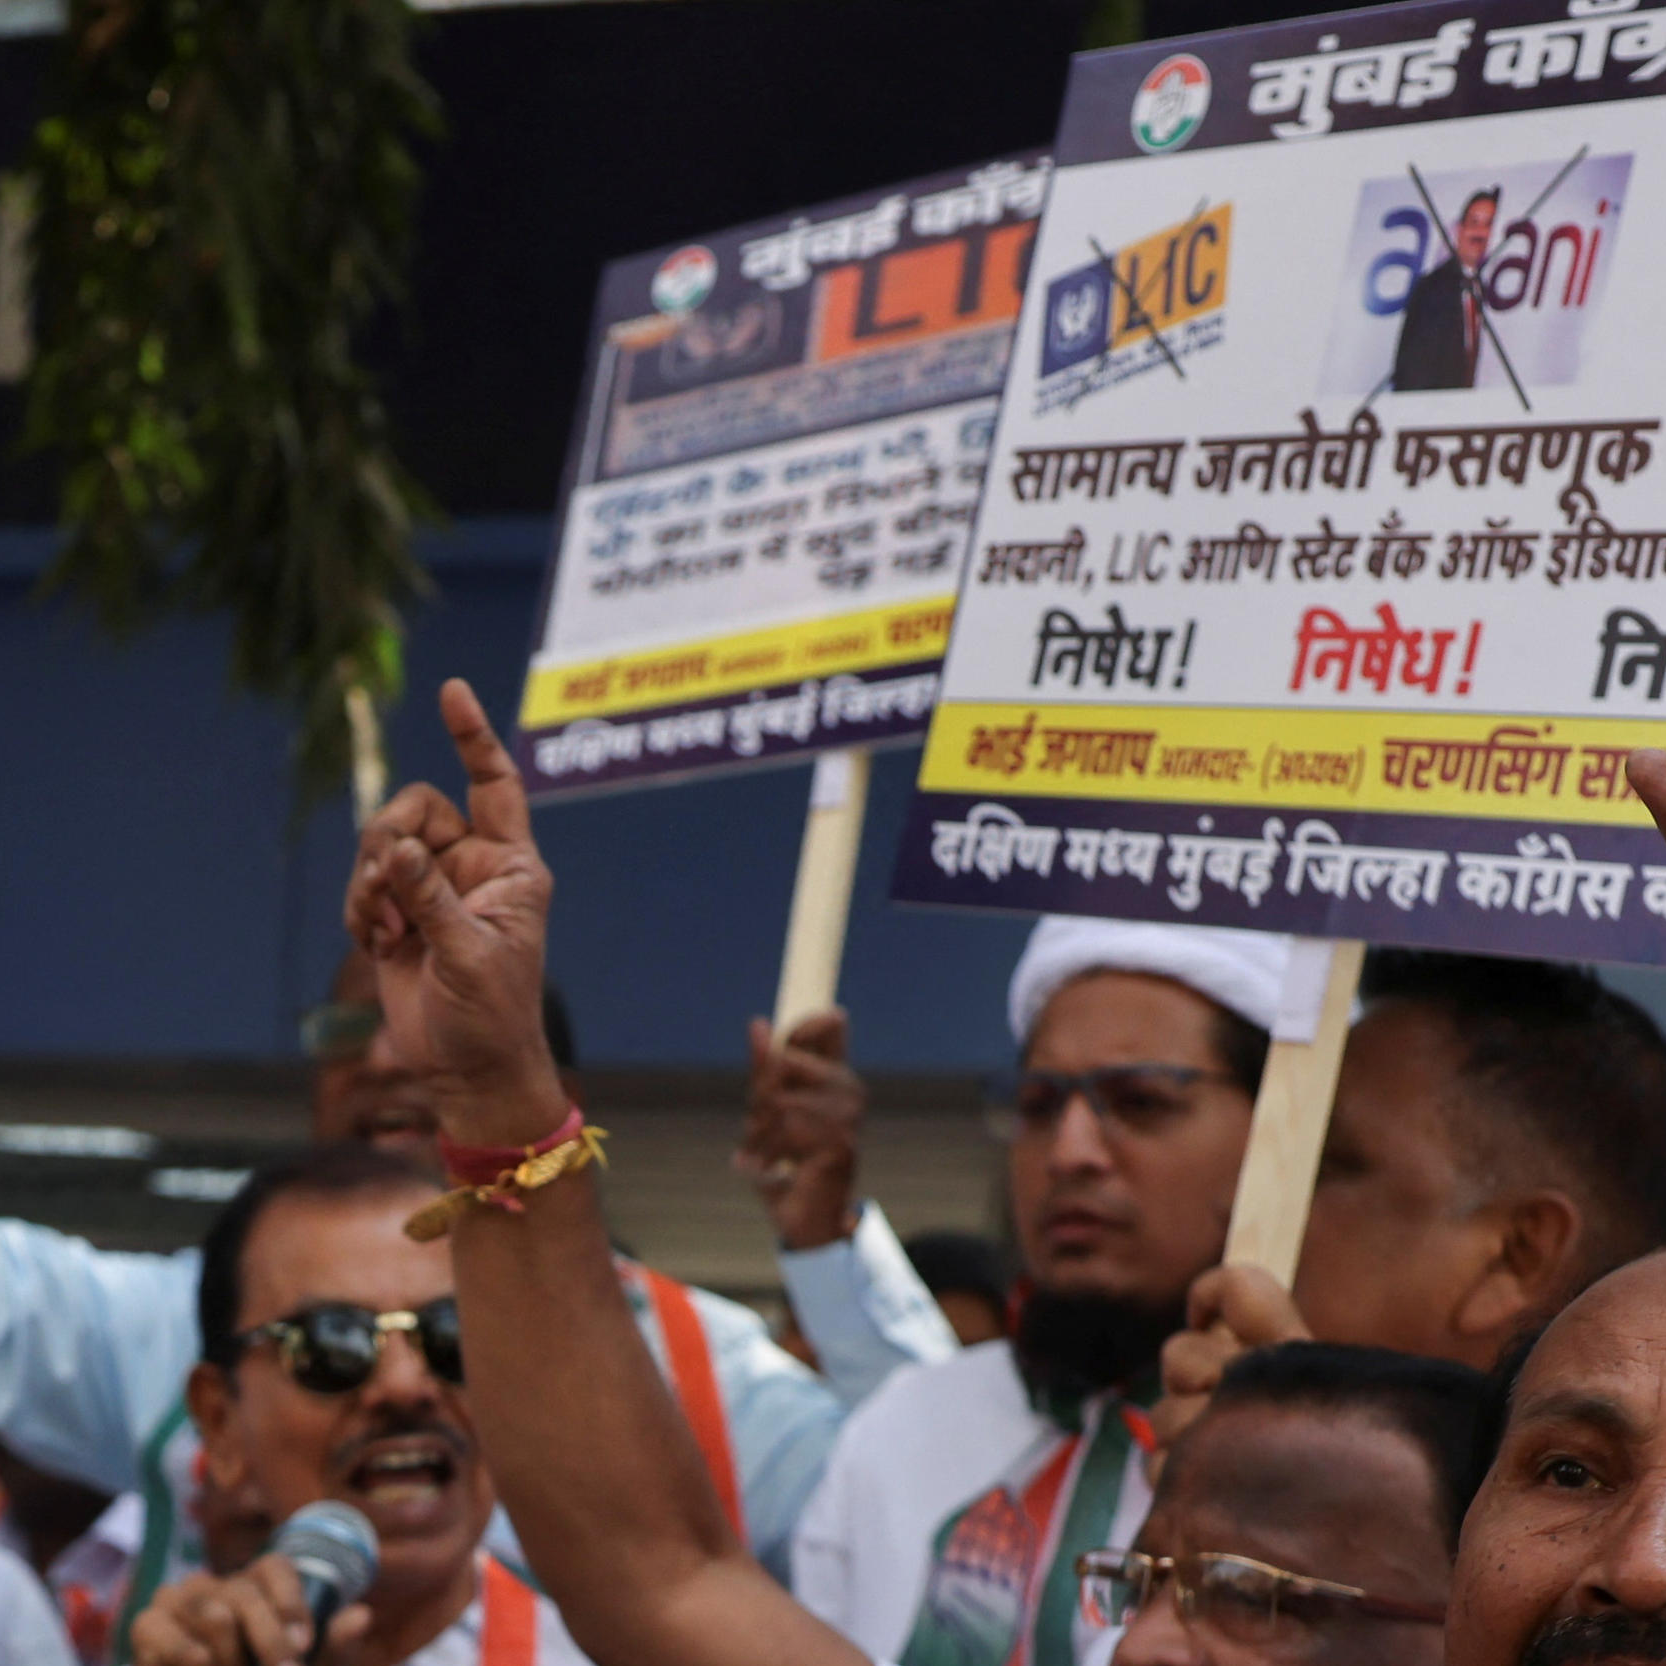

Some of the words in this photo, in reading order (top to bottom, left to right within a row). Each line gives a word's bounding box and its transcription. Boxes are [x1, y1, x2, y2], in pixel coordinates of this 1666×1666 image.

[1247, 18, 1475, 140] मुंबई
[851, 226, 1037, 340] LI
[1123, 222, 1219, 332] LIC
[1362, 186, 1611, 318] aani
[1012, 438, 1187, 500] सामान्य
[1194, 407, 1383, 494] जनतेची
[1393, 418, 1661, 525] फसवणूक
[1106, 531, 1174, 583] LIC
[1181, 520, 1283, 581] आणि
[1289, 514, 1361, 581] स्टेट
[1439, 515, 1539, 581] ऑफ
[1381, 723, 1572, 797] चरणसिंग
[931, 801, 1061, 882] दक्षिण
[1063, 826, 1164, 885] मध्य
[1167, 815, 1286, 912] मुंबई
[1285, 817, 1451, 911] जिल्हा
